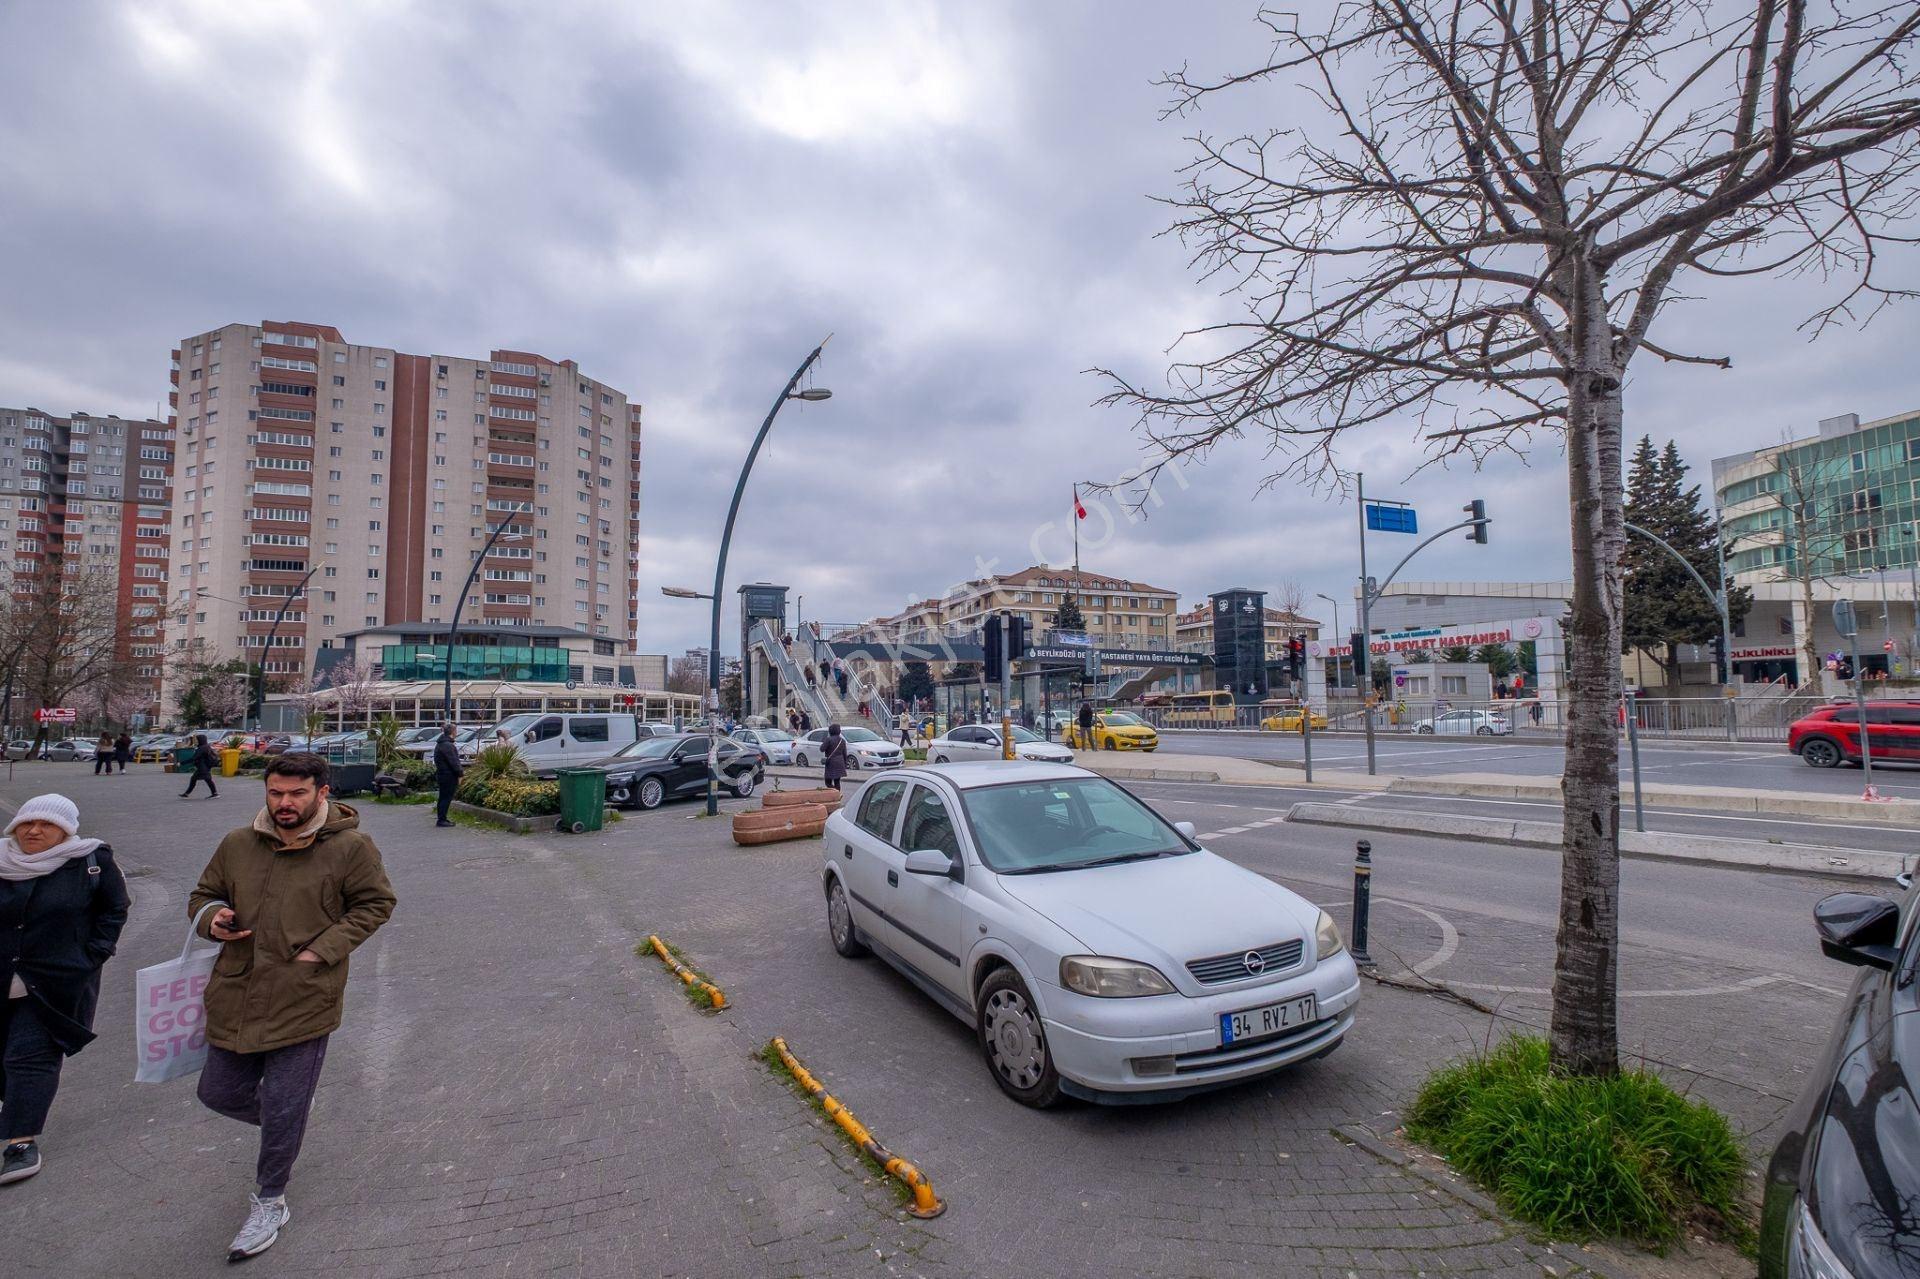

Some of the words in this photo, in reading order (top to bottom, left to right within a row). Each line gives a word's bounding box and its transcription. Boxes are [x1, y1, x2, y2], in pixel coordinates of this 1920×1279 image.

[1037, 649, 1076, 659] BEYLİKDÜZÜ
[1101, 652, 1135, 661] HASTANESİ
[1135, 654, 1151, 662] YAYA
[1152, 653, 1163, 662] ÜST
[1393, 638, 1436, 652] DEVLET
[1439, 629, 1511, 648] HASTANESİ
[40, 707, 76, 717] MCS
[150, 974, 209, 1007] FEE
[149, 1003, 205, 1034] GO
[1232, 1014, 1251, 1037] 34
[1262, 1005, 1289, 1031] RVZ
[1298, 999, 1313, 1022] 17
[147, 1027, 206, 1062] STO
